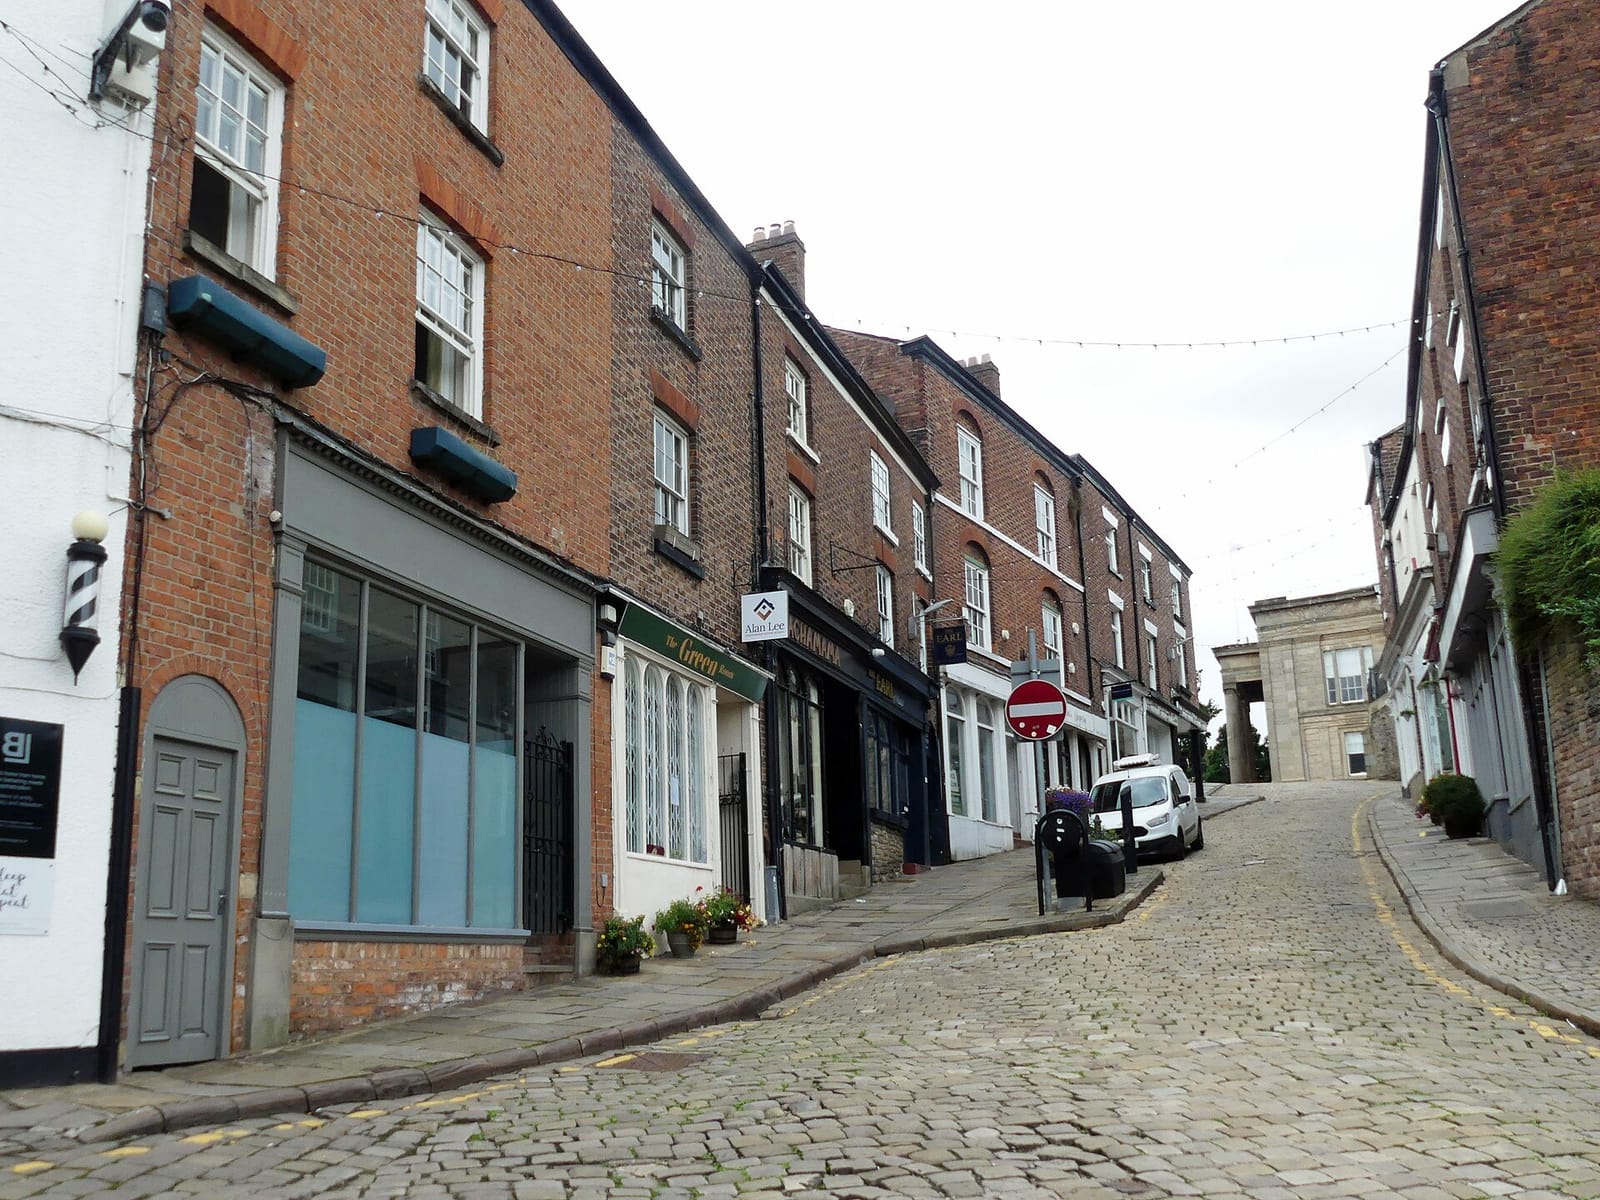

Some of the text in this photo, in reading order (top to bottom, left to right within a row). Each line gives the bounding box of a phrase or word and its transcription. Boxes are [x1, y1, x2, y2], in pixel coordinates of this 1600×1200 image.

[745, 623, 766, 634] Alan
[768, 622, 785, 632] Lee
[789, 615, 841, 667] ACHAMAMA
[936, 632, 962, 643] EARL
[665, 634, 678, 649] The
[679, 638, 718, 676] Green
